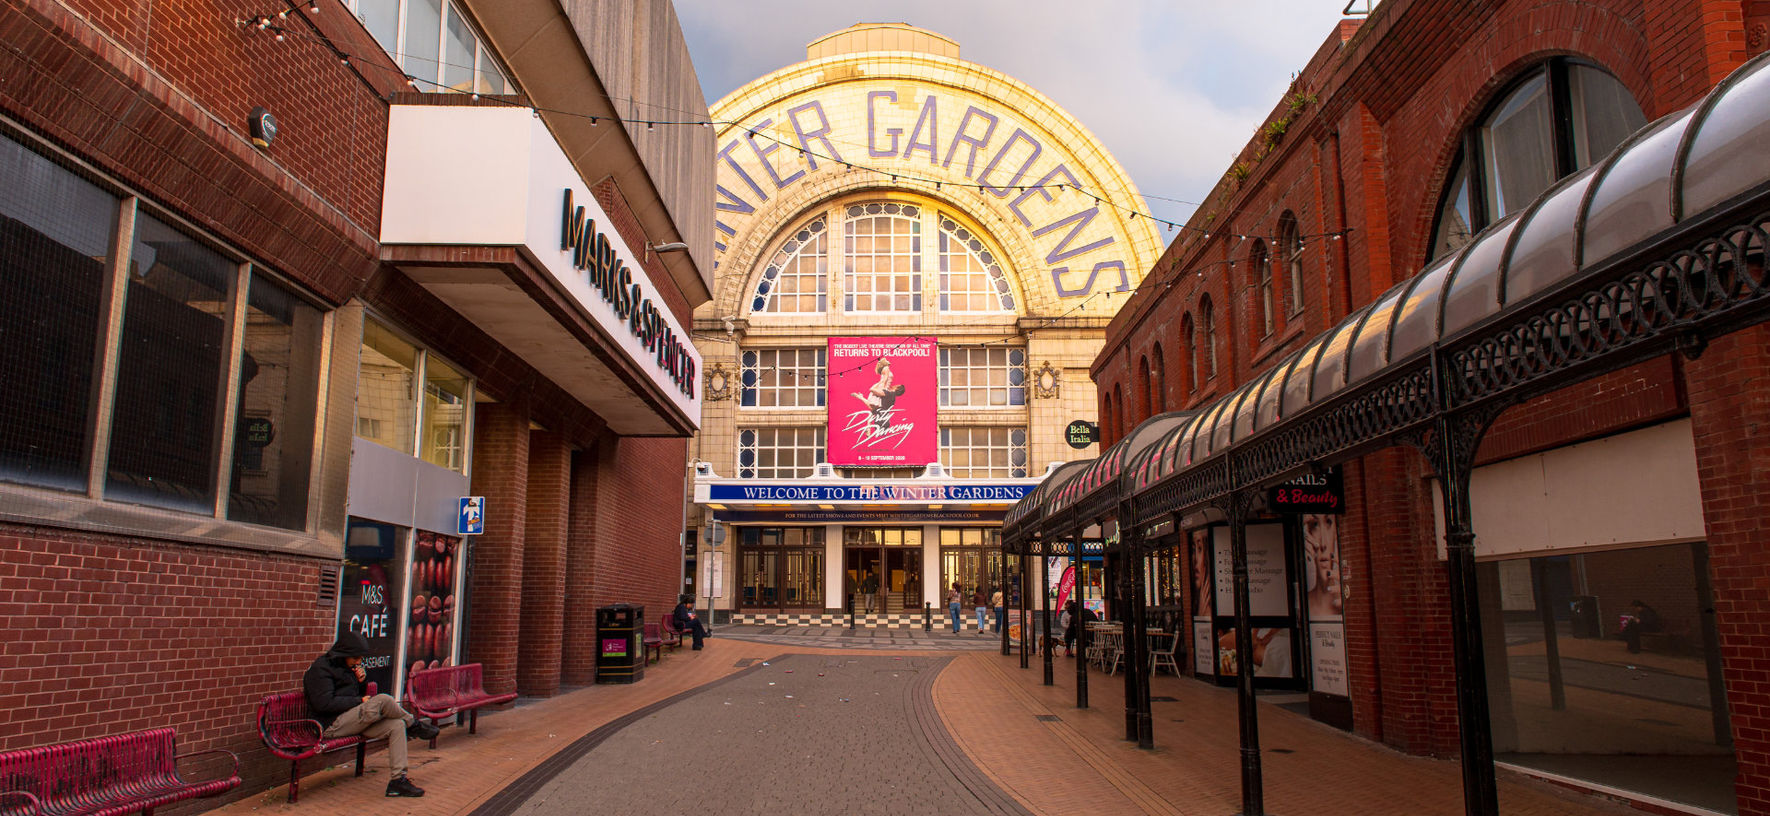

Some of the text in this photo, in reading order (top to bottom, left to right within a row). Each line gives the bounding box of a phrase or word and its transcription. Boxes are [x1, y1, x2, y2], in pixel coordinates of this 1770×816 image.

[866, 90, 1129, 298] GARDENS
[560, 188, 632, 320] MARKS
[641, 298, 696, 399] SPENCER
[834, 348, 930, 357] RETURNS TO BLACKPOOL!
[841, 405, 905, 432] Dirty
[850, 418, 914, 450] Dancing
[1070, 425, 1091, 434] Bella
[1070, 435, 1091, 443] Italia
[744, 487, 1024, 499] WELCOME TO THE WINTER GARDENS
[1276, 488, 1338, 508] & Beauty
[361, 584, 384, 605] M&S
[349, 606, 388, 638] CAFÉ
